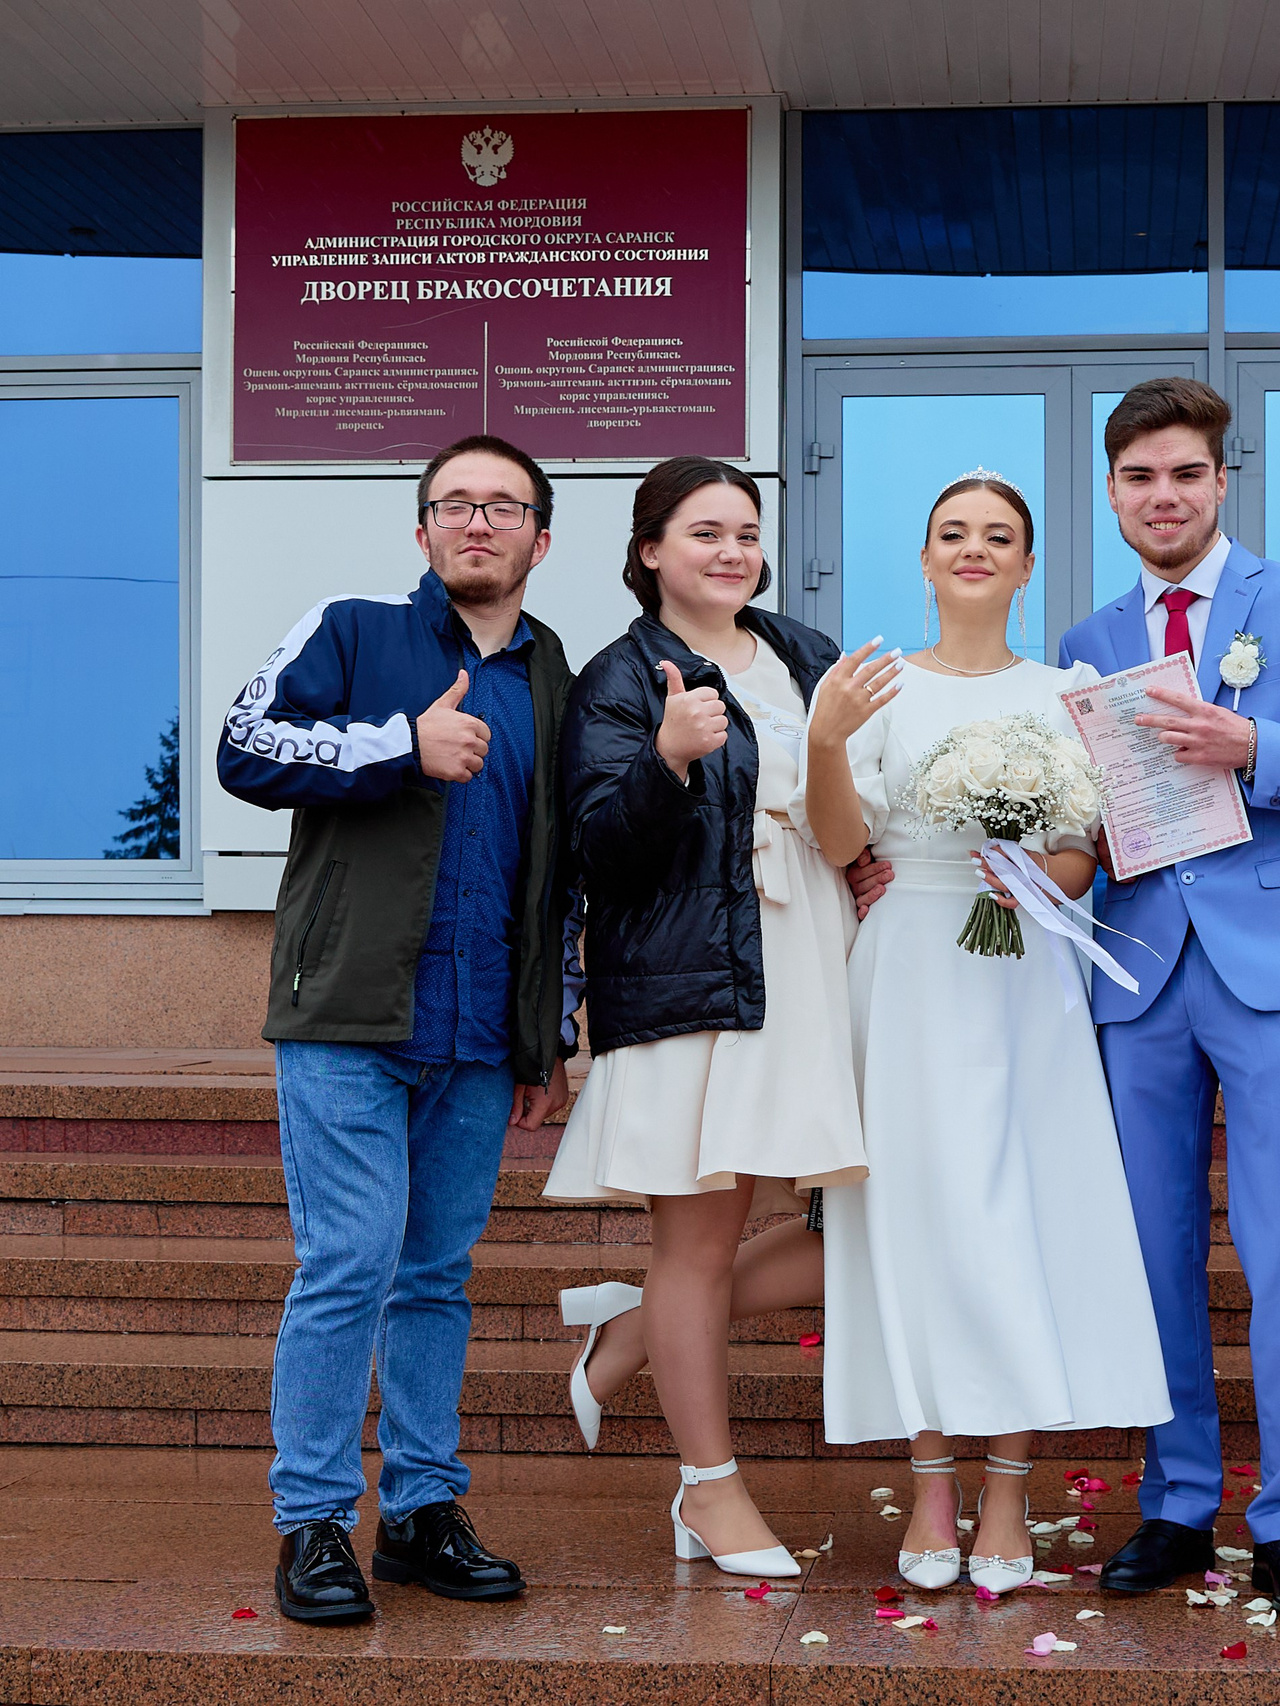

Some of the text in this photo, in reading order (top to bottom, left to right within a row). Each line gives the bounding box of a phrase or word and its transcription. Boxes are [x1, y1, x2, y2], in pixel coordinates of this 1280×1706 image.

[391, 198, 587, 213] РОССИЙСКАЯ ФЕДЕРАЦИЯ
[396, 215, 582, 230] РЕСПУБЛИКА МОРДОВИЯ
[304, 231, 675, 251] АДМИНИСТРАЦИЯ ГОРОДСКОГО ОКРУГА САРАНСК
[271, 248, 709, 268] УПРАВЛЕНИЕ ЗАПИСИ АКТОВ ГРАЖДАНСКОГО СОСТОЯНИЯ
[301, 277, 672, 305] ДВОРЕЦ БРАКОСОЧЕТАНИЯ
